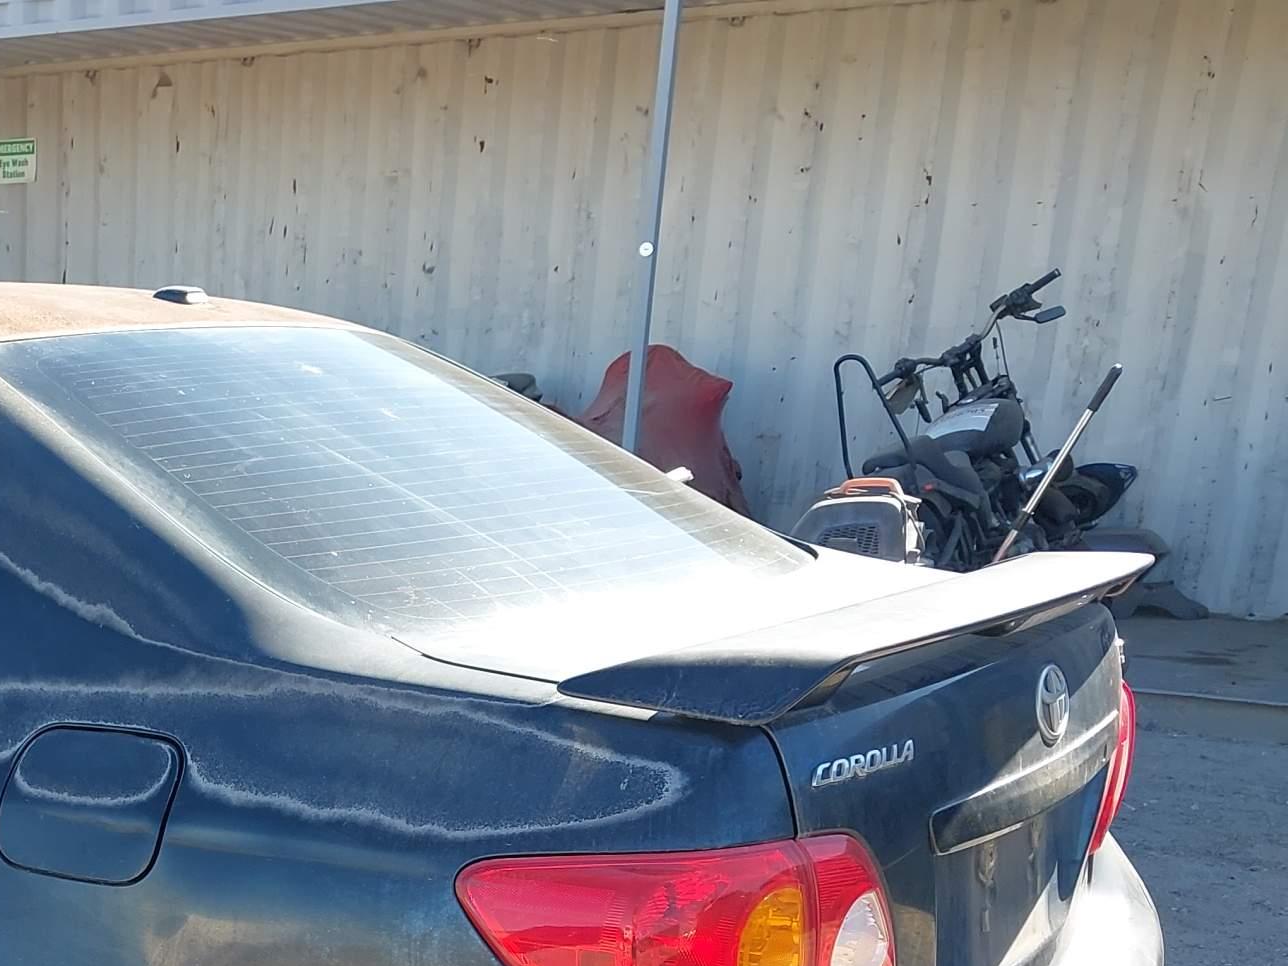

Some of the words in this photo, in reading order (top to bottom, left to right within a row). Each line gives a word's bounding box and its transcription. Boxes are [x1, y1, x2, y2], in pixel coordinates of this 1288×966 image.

[0, 159, 11, 170] Eye
[12, 158, 29, 167] Wash
[2, 170, 25, 179] Station
[811, 739, 914, 787] COROLLA
